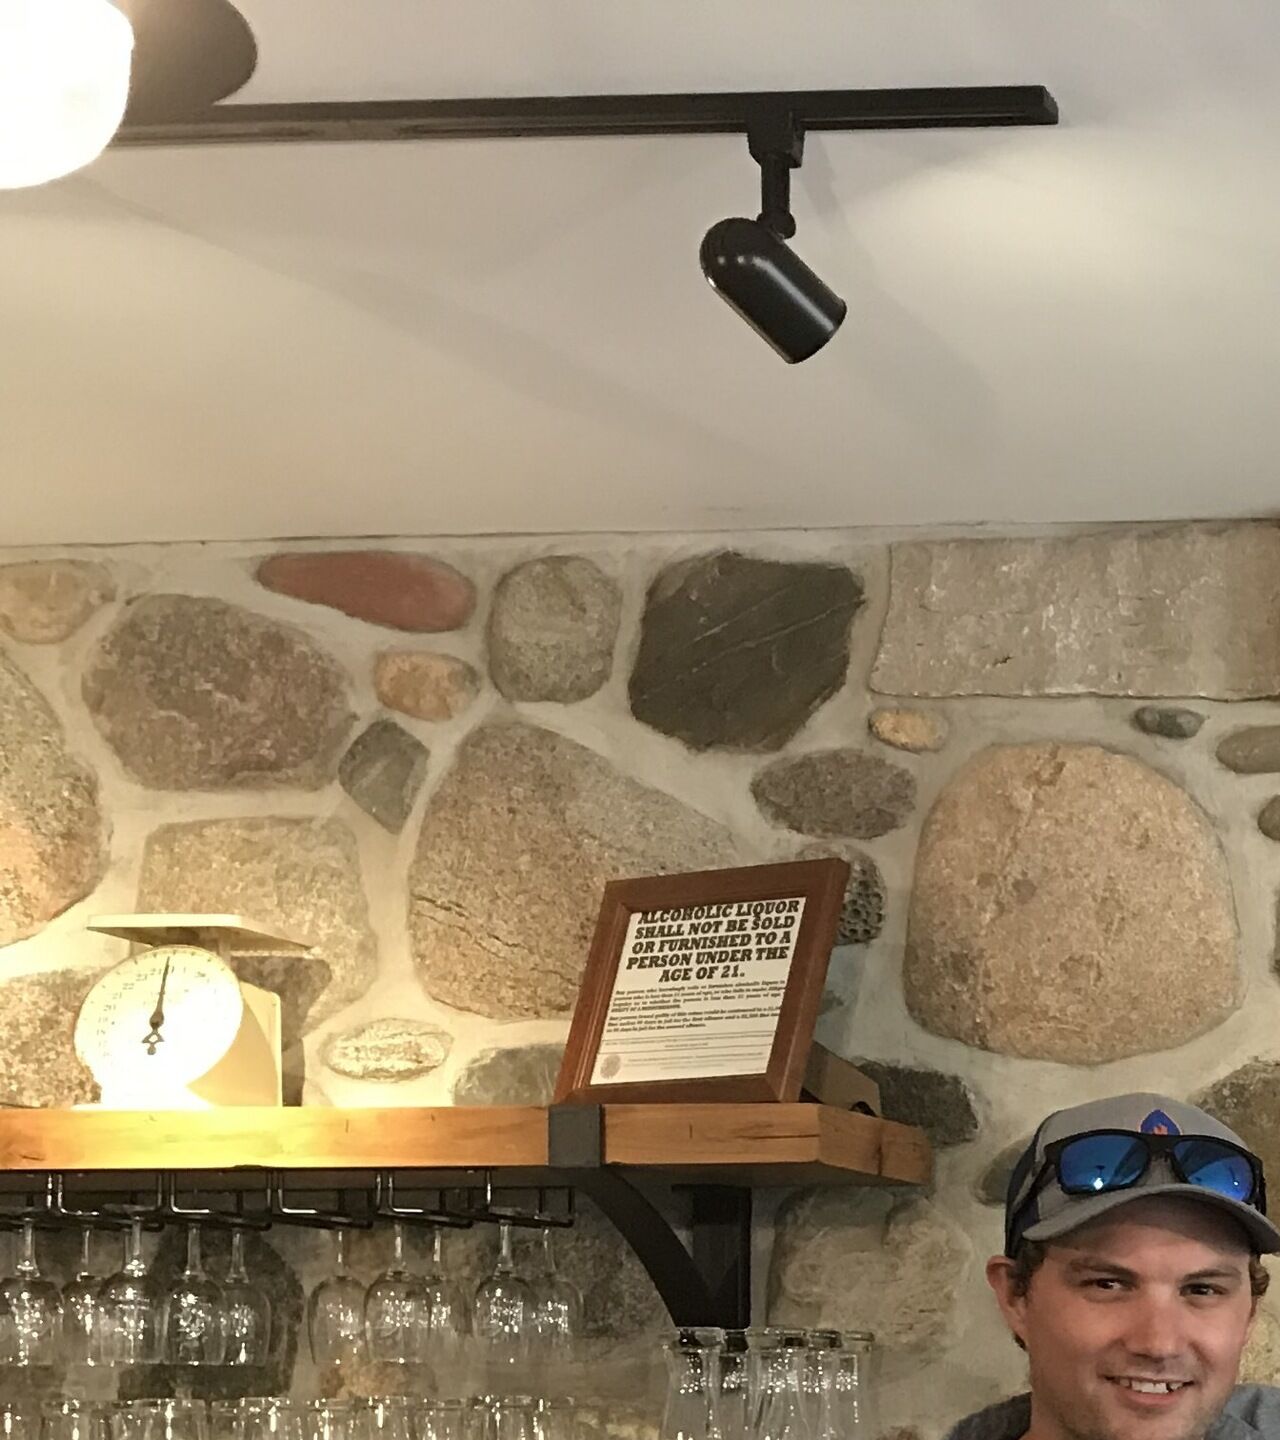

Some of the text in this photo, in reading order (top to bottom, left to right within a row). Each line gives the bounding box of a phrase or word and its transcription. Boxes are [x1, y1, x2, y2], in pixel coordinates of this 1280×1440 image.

[637, 899, 801, 925] ALCOHOLIC LIQUOR
[634, 914, 796, 940] SHALL NOT BE SOLD
[631, 930, 792, 955] OR FURNISHED TO A
[625, 946, 791, 971] PERSON UNDER THE
[658, 964, 745, 983] AGE OF 21.
